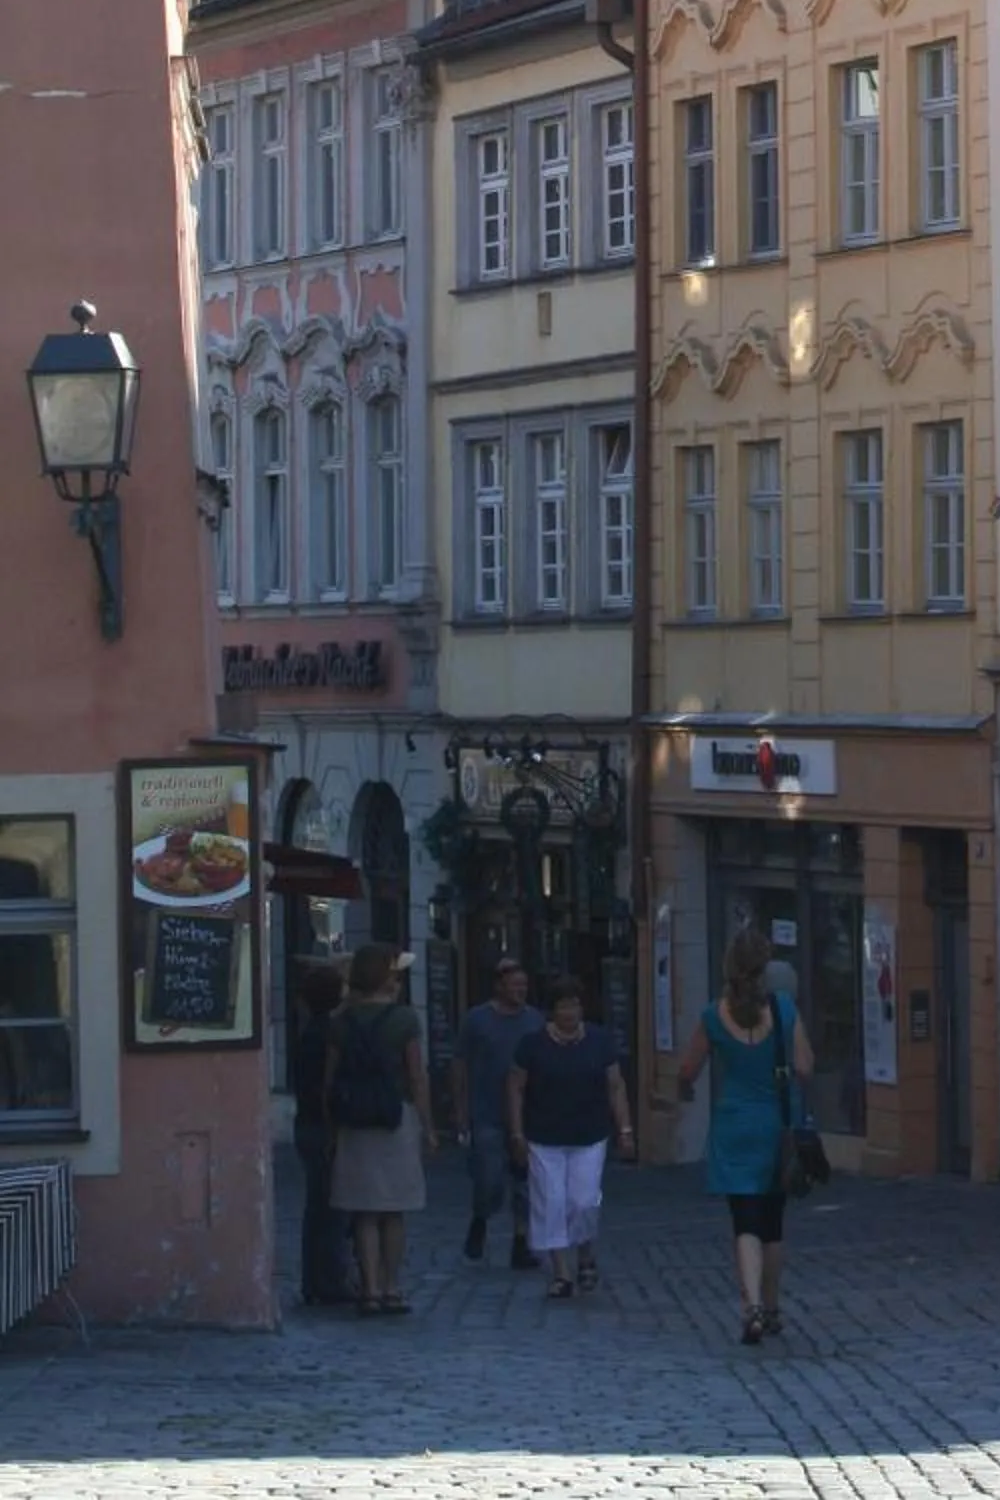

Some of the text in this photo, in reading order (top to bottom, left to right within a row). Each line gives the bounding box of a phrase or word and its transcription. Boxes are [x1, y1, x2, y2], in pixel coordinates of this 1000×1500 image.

[141, 775, 223, 790] traditionell
[141, 794, 218, 808] & regional
